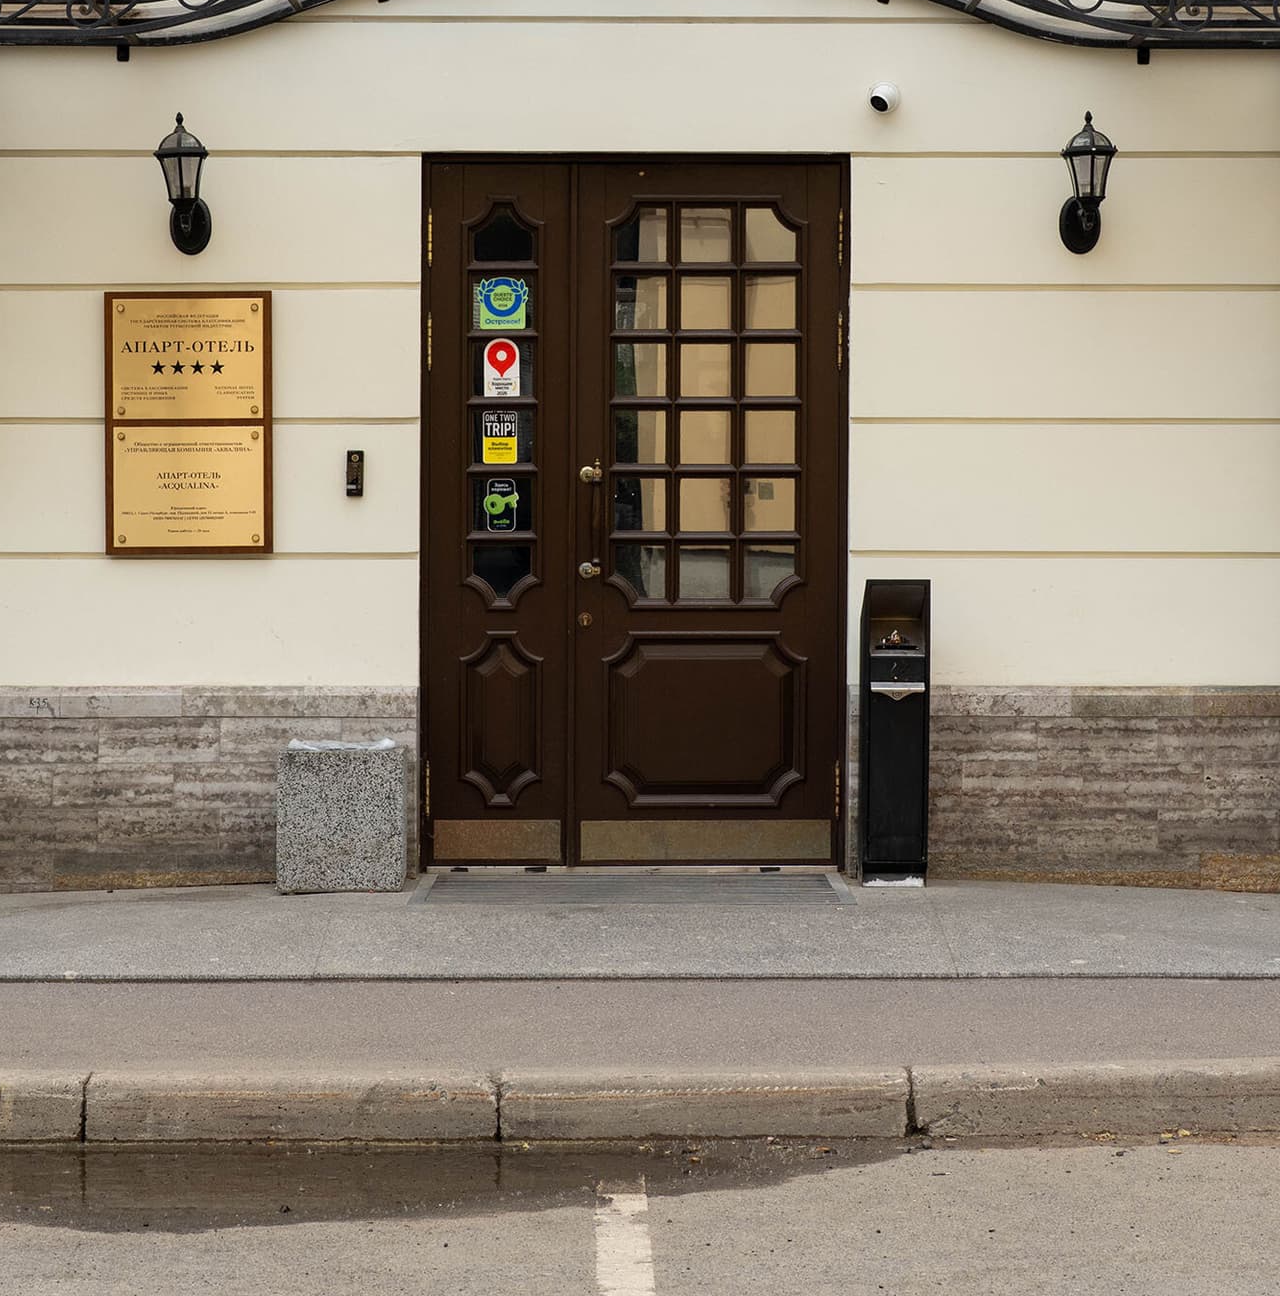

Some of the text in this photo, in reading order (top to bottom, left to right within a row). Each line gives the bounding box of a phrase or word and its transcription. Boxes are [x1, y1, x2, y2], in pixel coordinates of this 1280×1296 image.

[121, 340, 255, 353] АПАРТ-ОТЕЛЬ
[485, 414, 515, 422] ONE TWO
[485, 422, 515, 436] TRIP!
[156, 472, 221, 480] АПАРТ-ОТЕЛЬ
